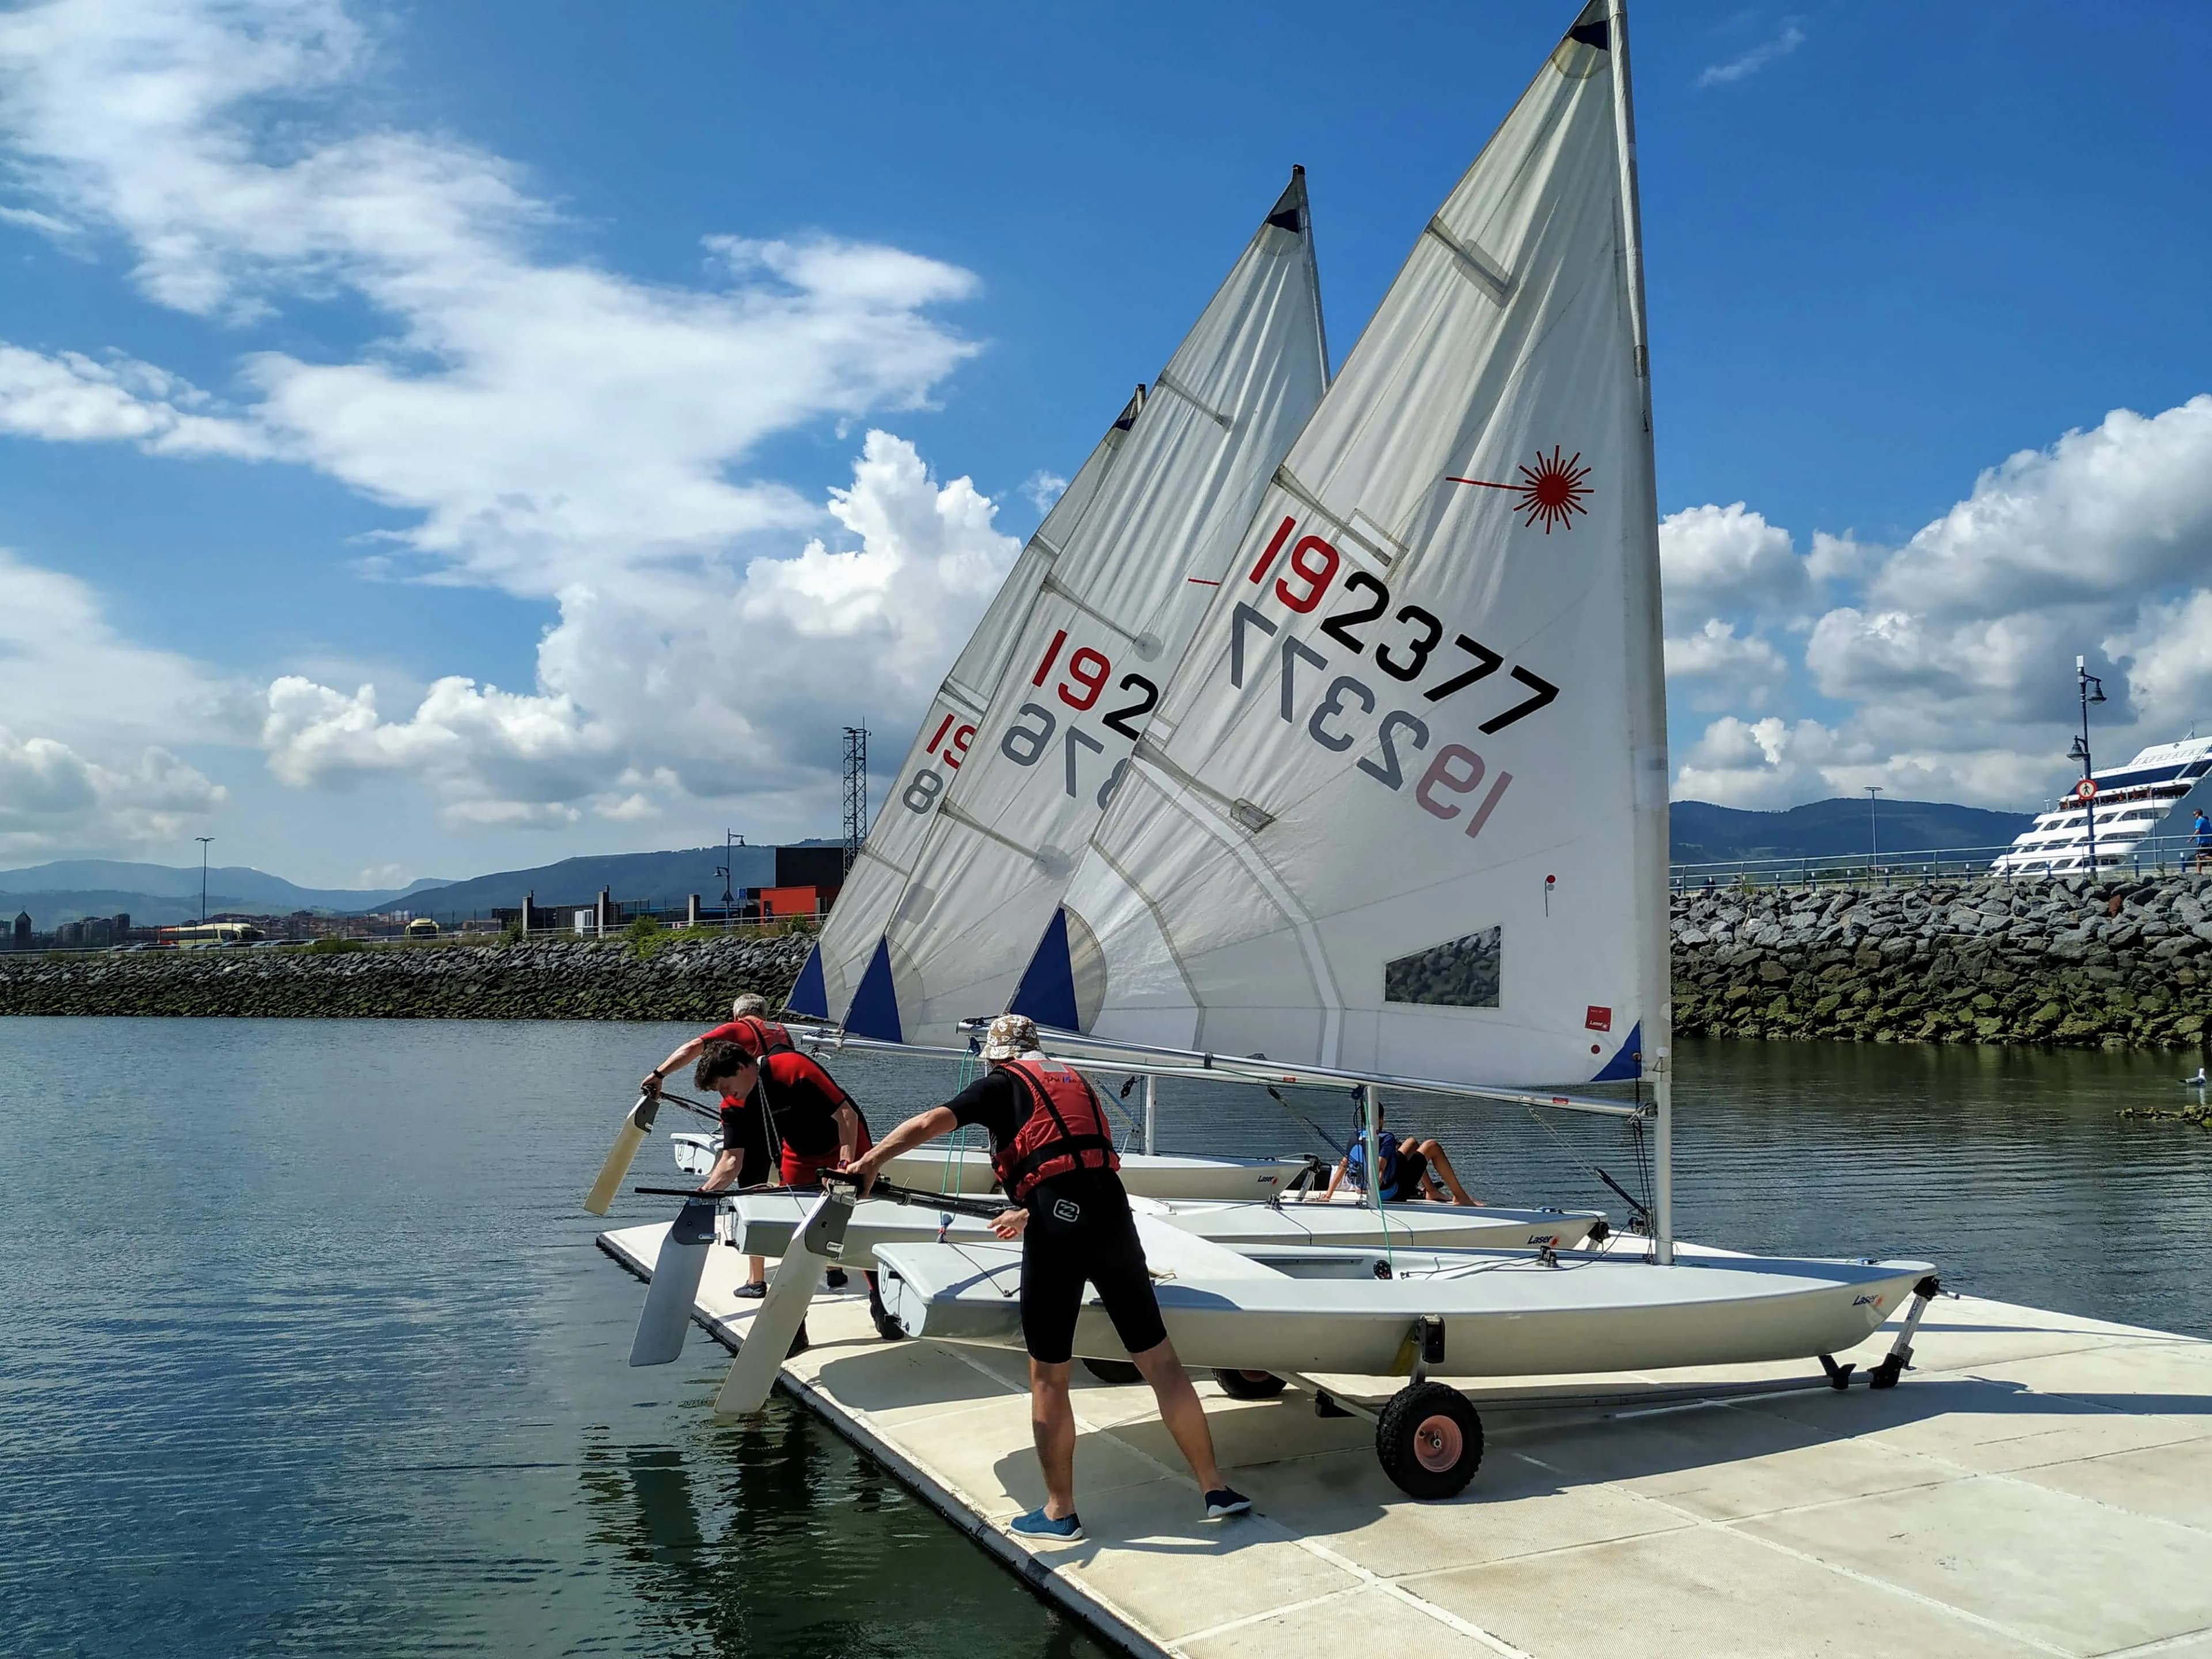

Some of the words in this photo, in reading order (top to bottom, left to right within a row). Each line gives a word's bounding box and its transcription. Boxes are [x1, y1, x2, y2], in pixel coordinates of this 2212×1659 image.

[1248, 516, 1560, 735] 192377
[1032, 629, 1158, 741] 192
[1527, 1235, 1554, 1244] Laser
